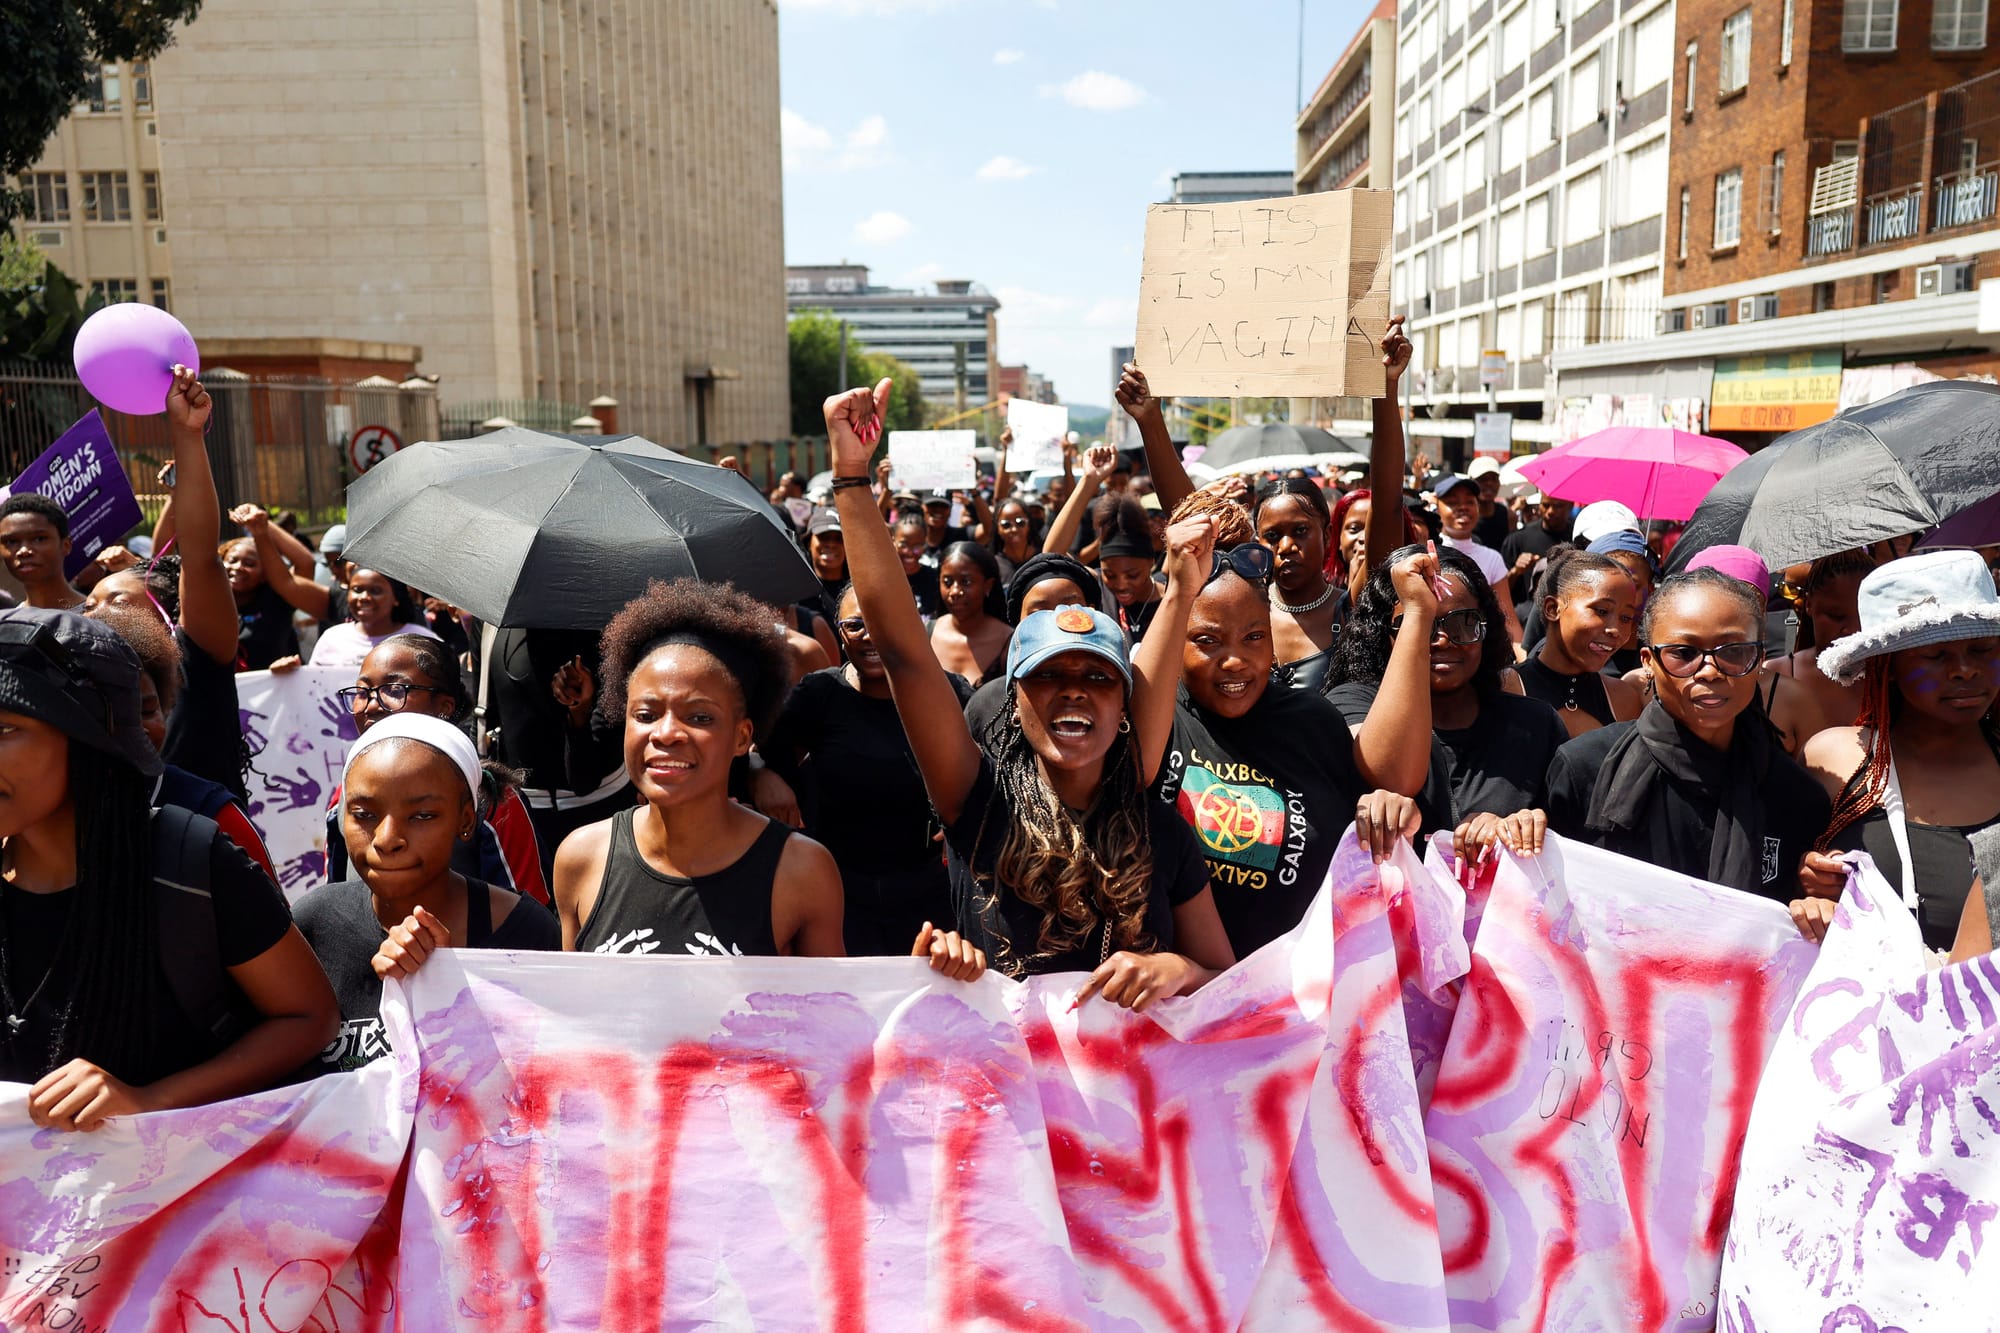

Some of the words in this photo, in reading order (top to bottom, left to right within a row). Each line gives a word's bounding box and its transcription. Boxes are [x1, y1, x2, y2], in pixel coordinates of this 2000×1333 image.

[1162, 204, 1318, 248] THIS
[1171, 268, 1226, 299] IS
[1254, 263, 1333, 291] MY
[1162, 315, 1375, 366] VAGINA
[1278, 788, 1307, 886] GALXBOY
[1204, 860, 1268, 890] GALX
[1538, 1067, 1586, 1126] TO
[1602, 1079, 1651, 1148] NO
